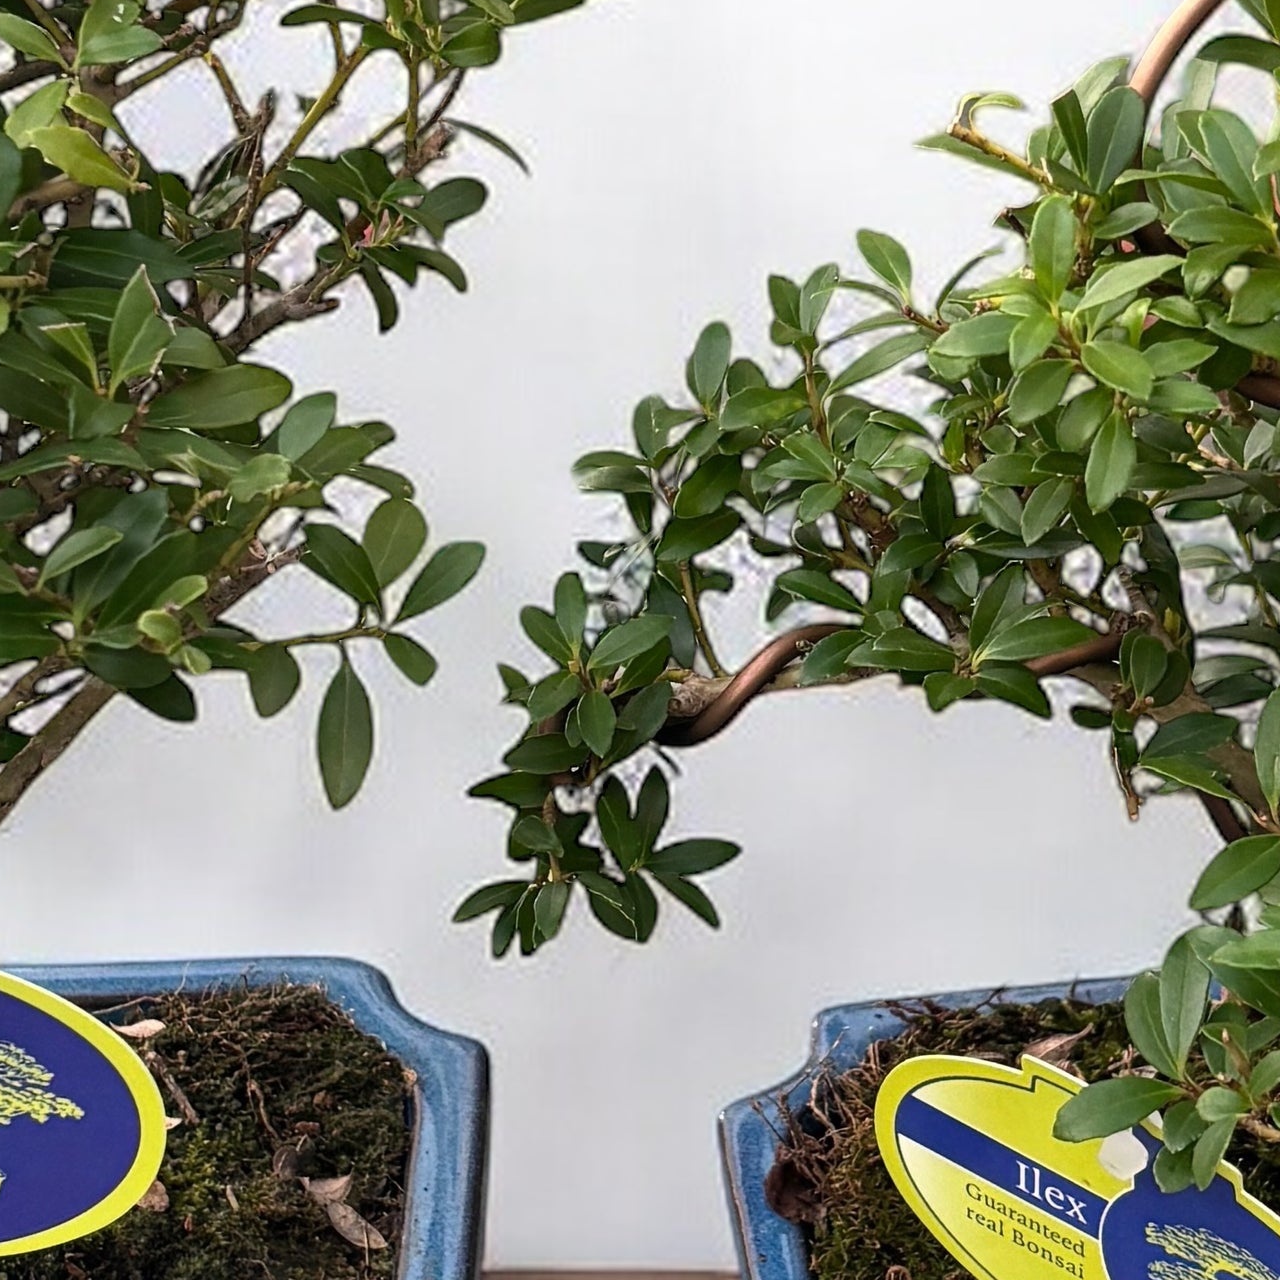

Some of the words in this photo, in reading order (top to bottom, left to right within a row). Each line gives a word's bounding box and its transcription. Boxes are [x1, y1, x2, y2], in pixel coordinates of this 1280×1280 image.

[965, 1182, 1086, 1258] Guaranteed
[1015, 1160, 1088, 1224] Ilex
[966, 1209, 1005, 1238] real
[1012, 1227, 1085, 1280] Bonsai
